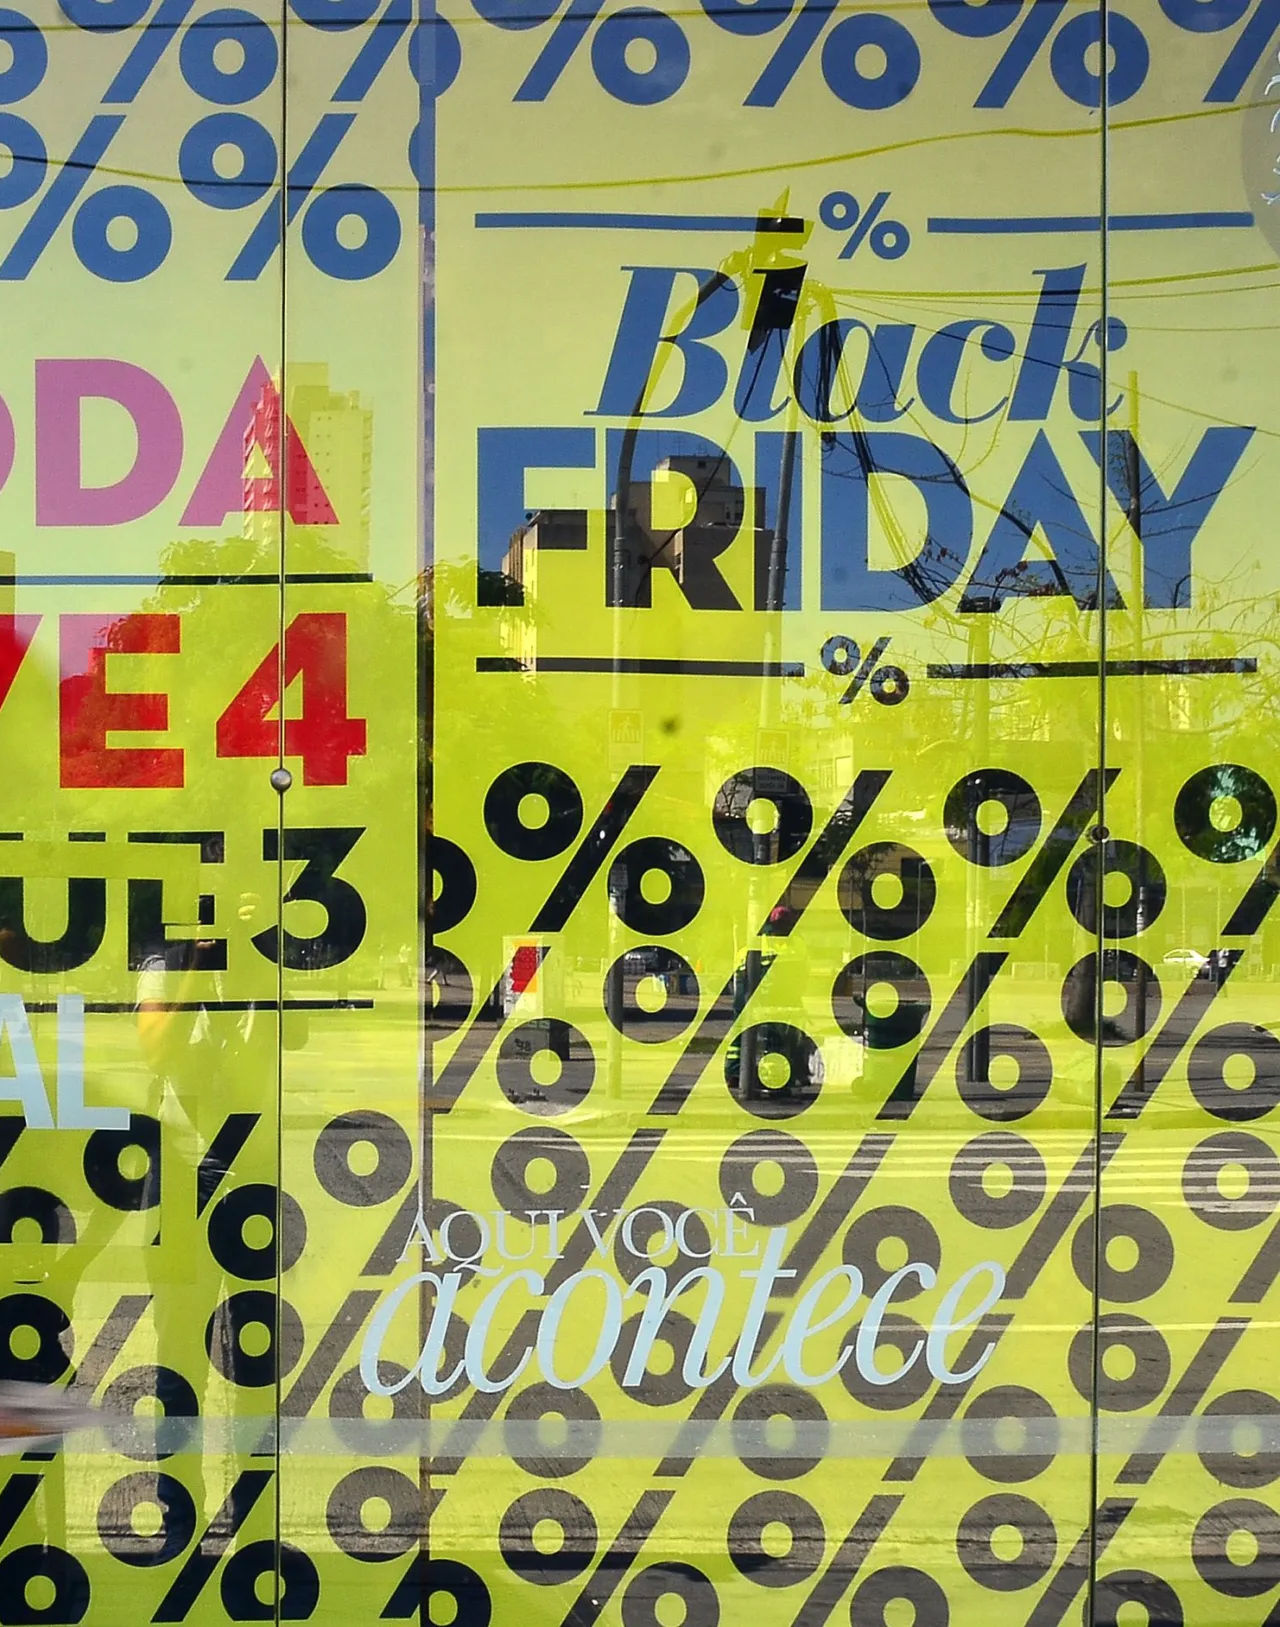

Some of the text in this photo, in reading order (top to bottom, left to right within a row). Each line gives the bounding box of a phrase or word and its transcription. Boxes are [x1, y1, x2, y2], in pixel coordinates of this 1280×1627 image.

[584, 263, 1134, 424] Black
[476, 426, 1257, 613] FRIDAY
[215, 612, 367, 788] 4
[251, 827, 368, 971] 3
[360, 1226, 1007, 1397] acontece
[397, 1192, 761, 1276] AQUI VOCÊ
